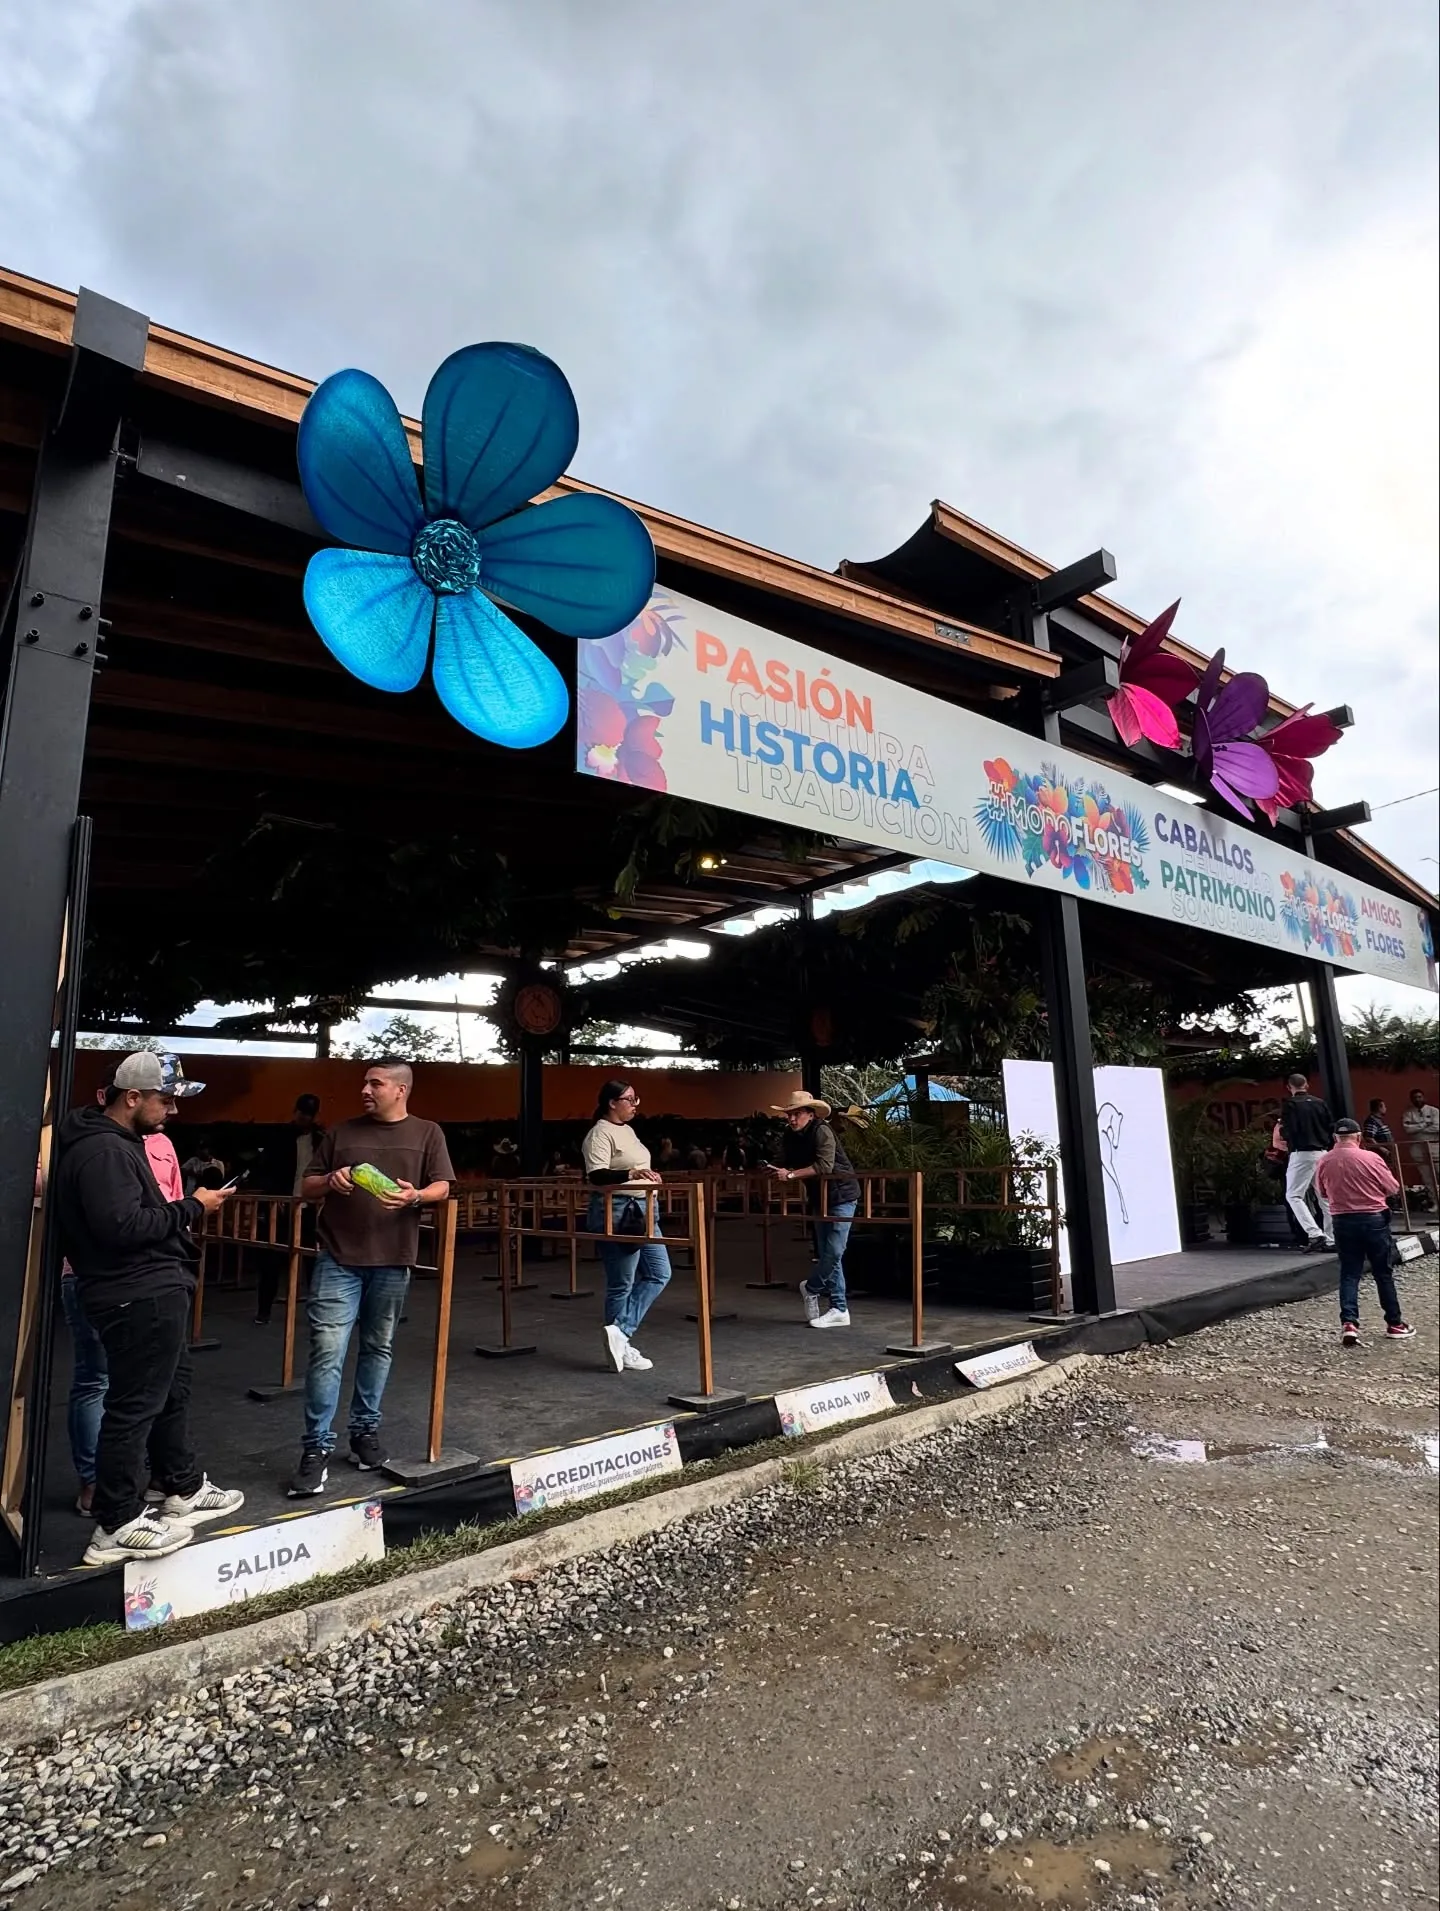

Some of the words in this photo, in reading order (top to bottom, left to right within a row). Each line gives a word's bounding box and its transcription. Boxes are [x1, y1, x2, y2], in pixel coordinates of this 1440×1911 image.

[695, 630, 873, 733] PASIÓN
[700, 700, 920, 809] HISTORIA
[730, 681, 935, 786] CULTURA
[726, 748, 969, 854] TRADICIÓN
[1154, 813, 1254, 874] CABALLOS
[1160, 859, 1275, 922] PATRIMONIO
[1361, 897, 1402, 928] AMIGOS
[1365, 929, 1405, 959] FLORES
[972, 1364, 1003, 1378] GRADA
[810, 1395, 852, 1415] GRADA
[850, 1390, 871, 1405] VIP
[533, 1442, 672, 1493] ACREDITACIONES
[217, 1543, 311, 1582] SALIDA
